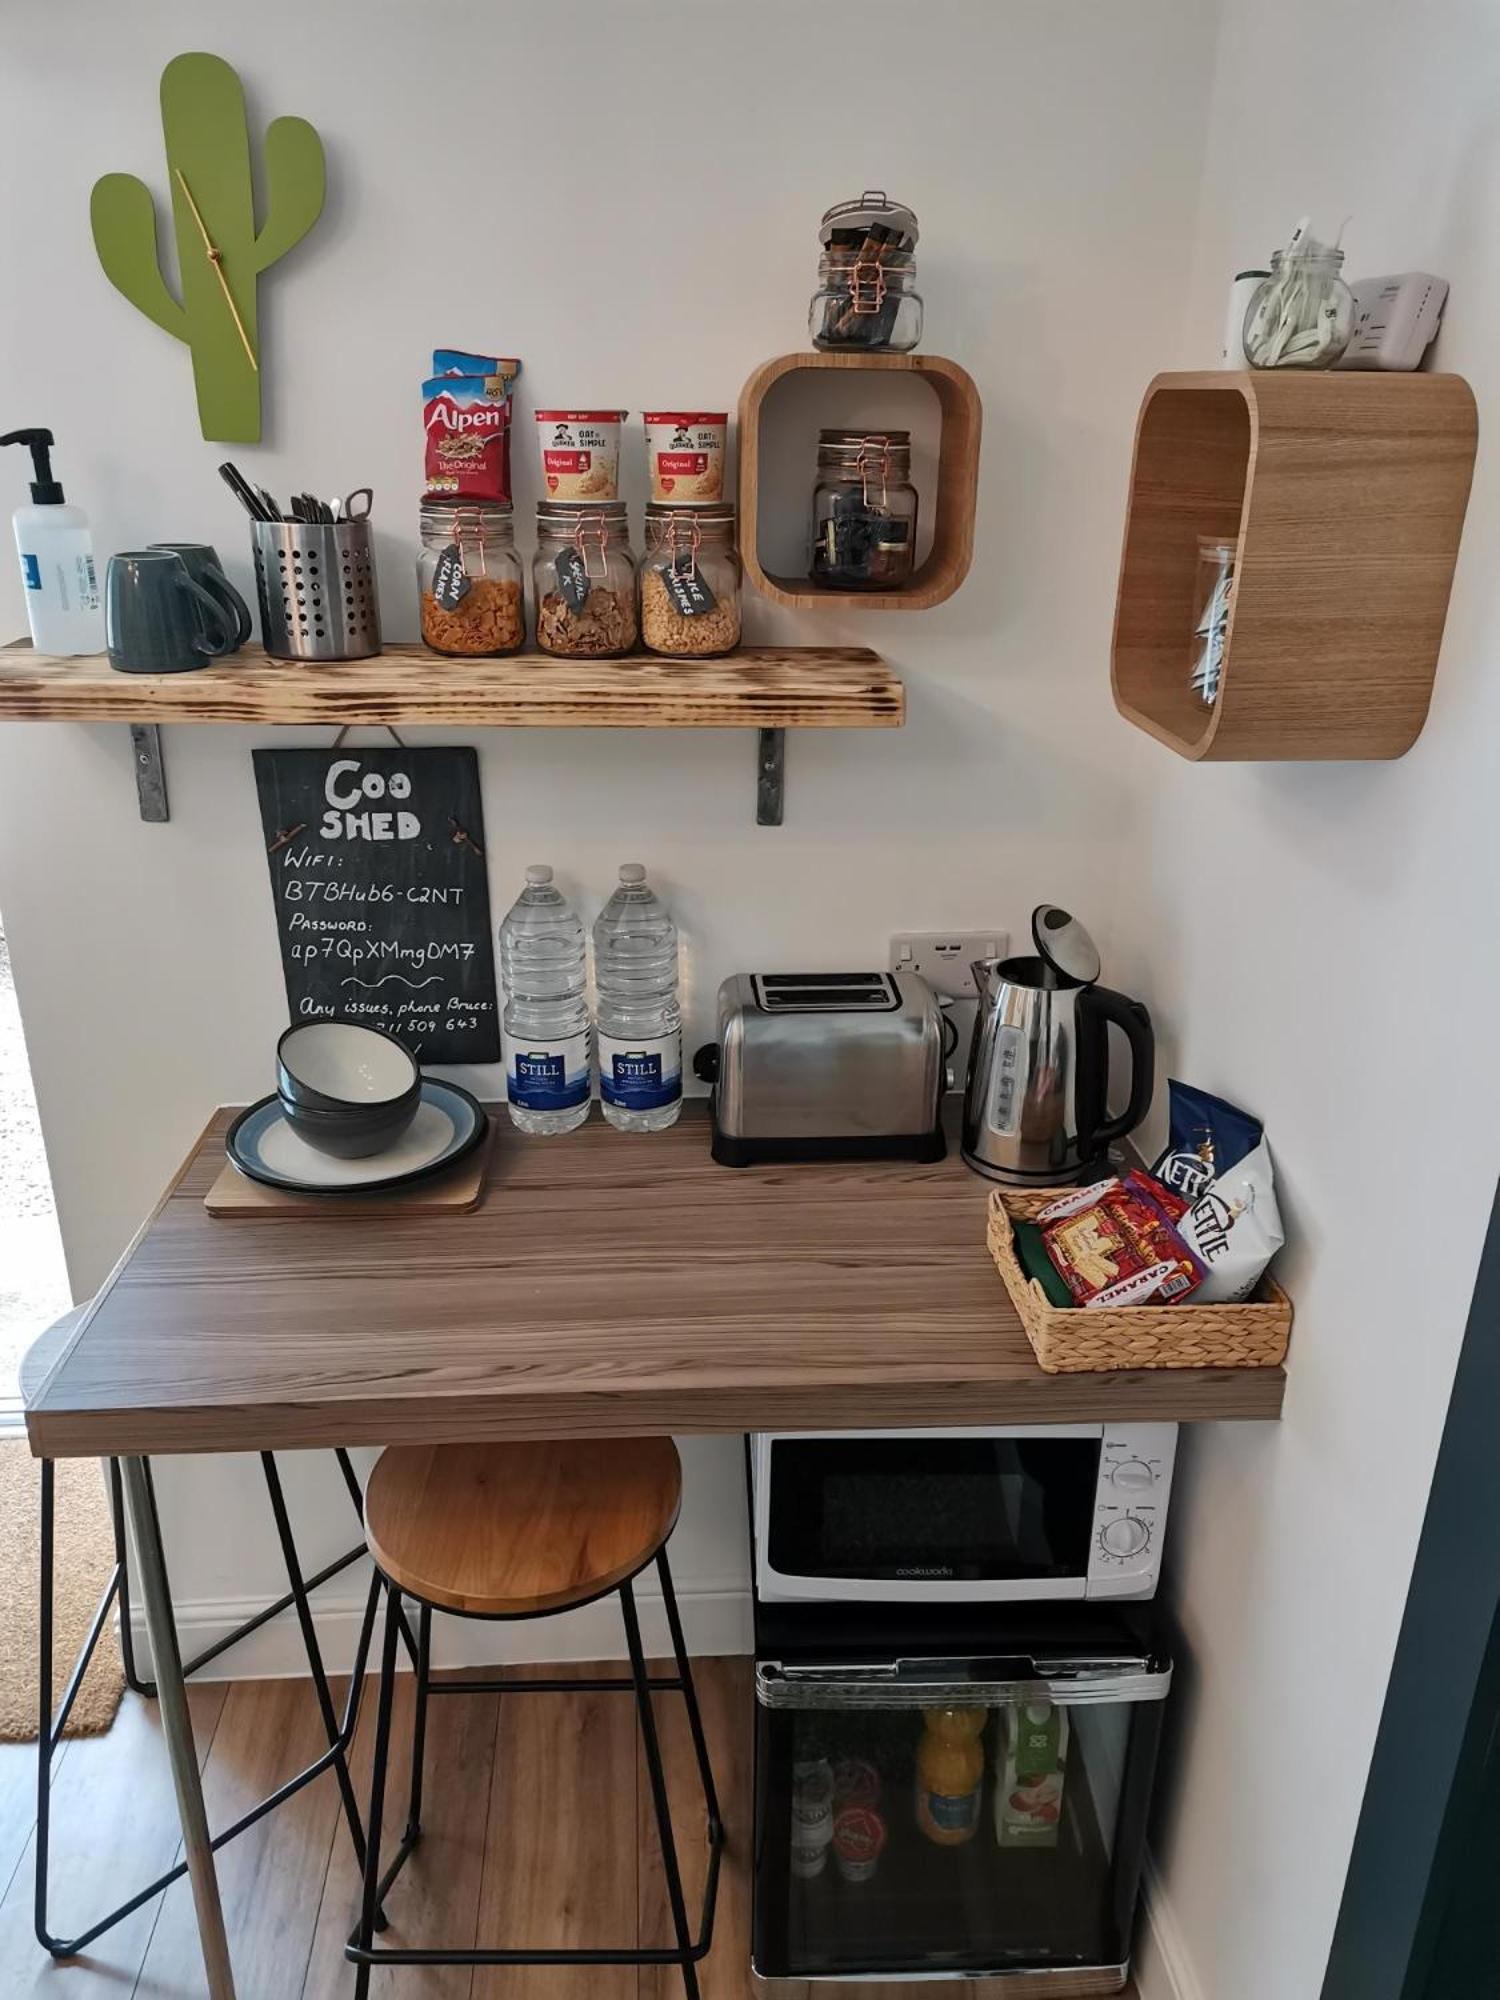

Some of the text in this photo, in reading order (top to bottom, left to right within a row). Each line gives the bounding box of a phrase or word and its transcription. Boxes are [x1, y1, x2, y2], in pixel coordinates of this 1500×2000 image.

[426, 403, 499, 432] Alpen
[454, 460, 486, 471] Original
[547, 457, 573, 468] Original
[662, 459, 691, 469] Original
[449, 563, 463, 600] CORN
[562, 575, 571, 586] K
[319, 811, 421, 841] SHED
[299, 996, 336, 1018] Any
[397, 999, 441, 1017] phone
[407, 1019, 436, 1033] 509
[446, 1017, 477, 1030] 643
[519, 1062, 560, 1076] STILL
[617, 1062, 657, 1076] STILL
[1156, 1150, 1215, 1197] KETT
[1044, 1181, 1109, 1216] CARAMEL
[1096, 1265, 1168, 1303] CARAMEL
